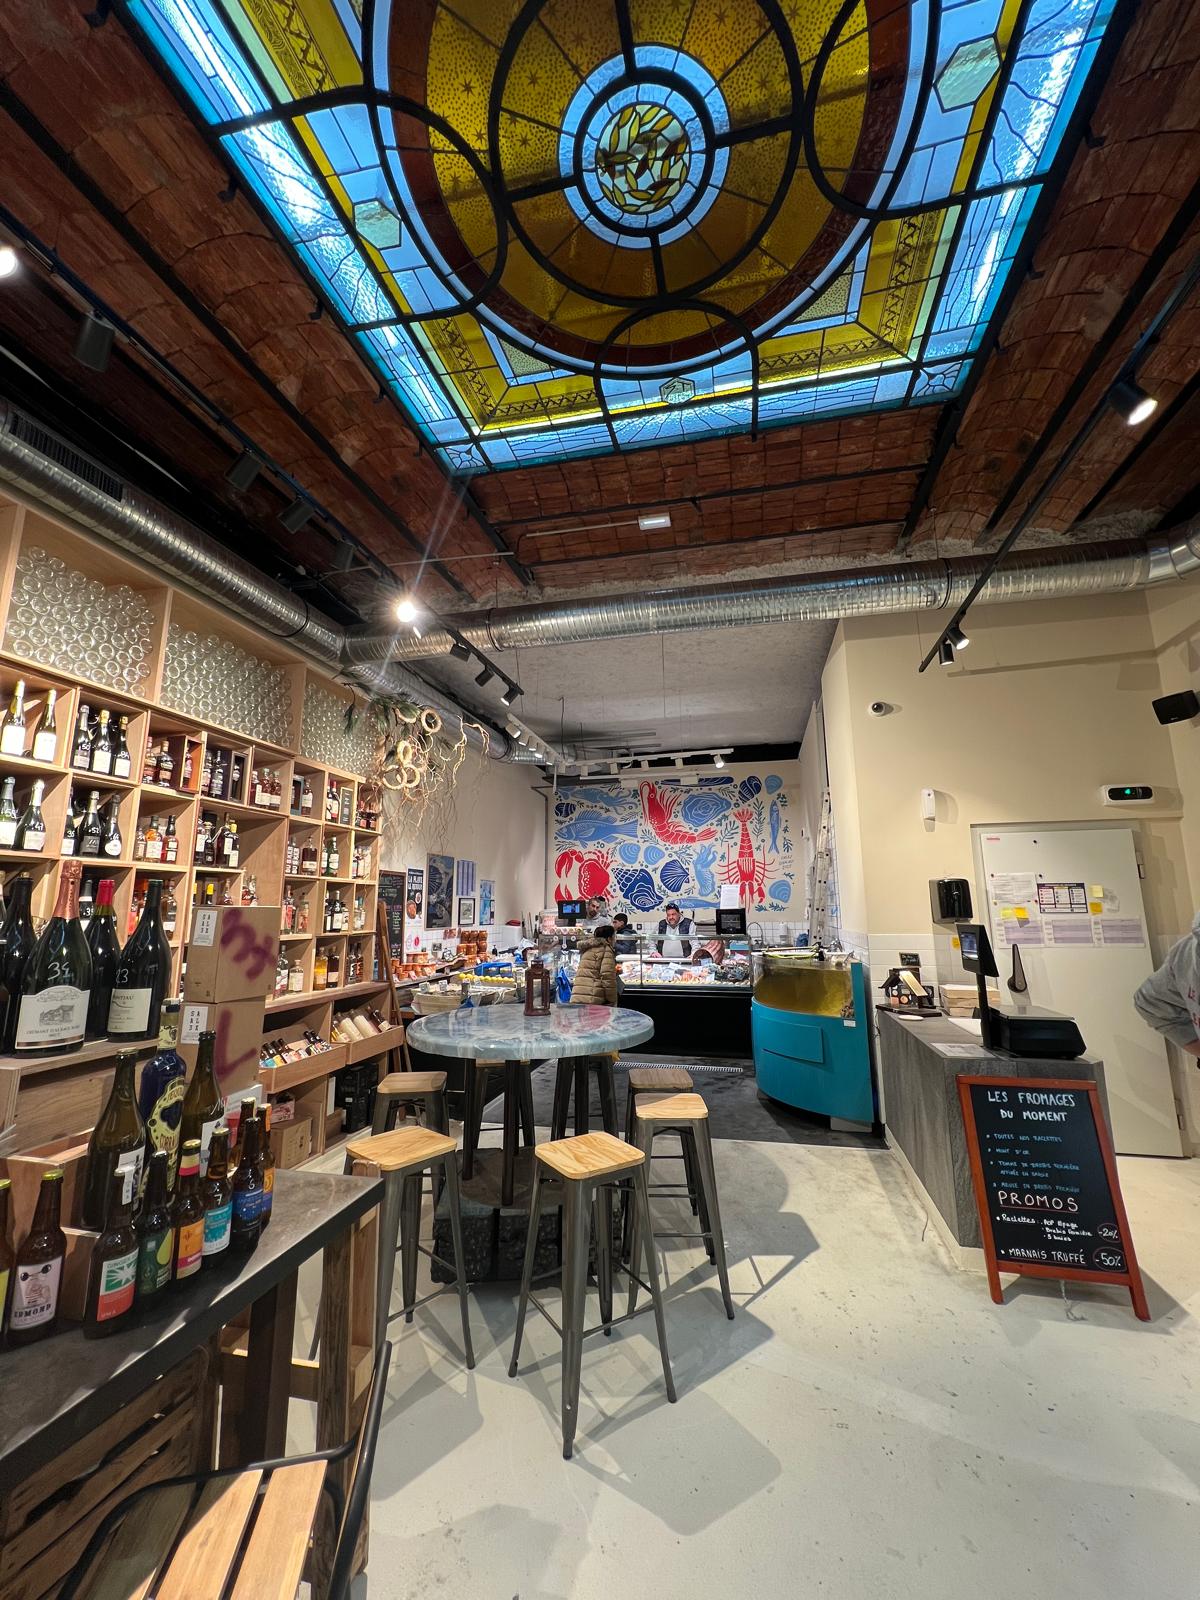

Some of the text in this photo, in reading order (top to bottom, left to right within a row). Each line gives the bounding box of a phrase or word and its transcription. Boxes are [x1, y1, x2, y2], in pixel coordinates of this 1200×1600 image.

[987, 1090, 1076, 1108] LES FROMAGES
[1000, 1108, 1068, 1122] DU MOMENT
[998, 1190, 1080, 1212] PROMOS
[1001, 1213, 1036, 1224] Raclettes
[1051, 1248, 1086, 1265] TRUFFÉ
[1095, 1252, 1122, 1267] -50%
